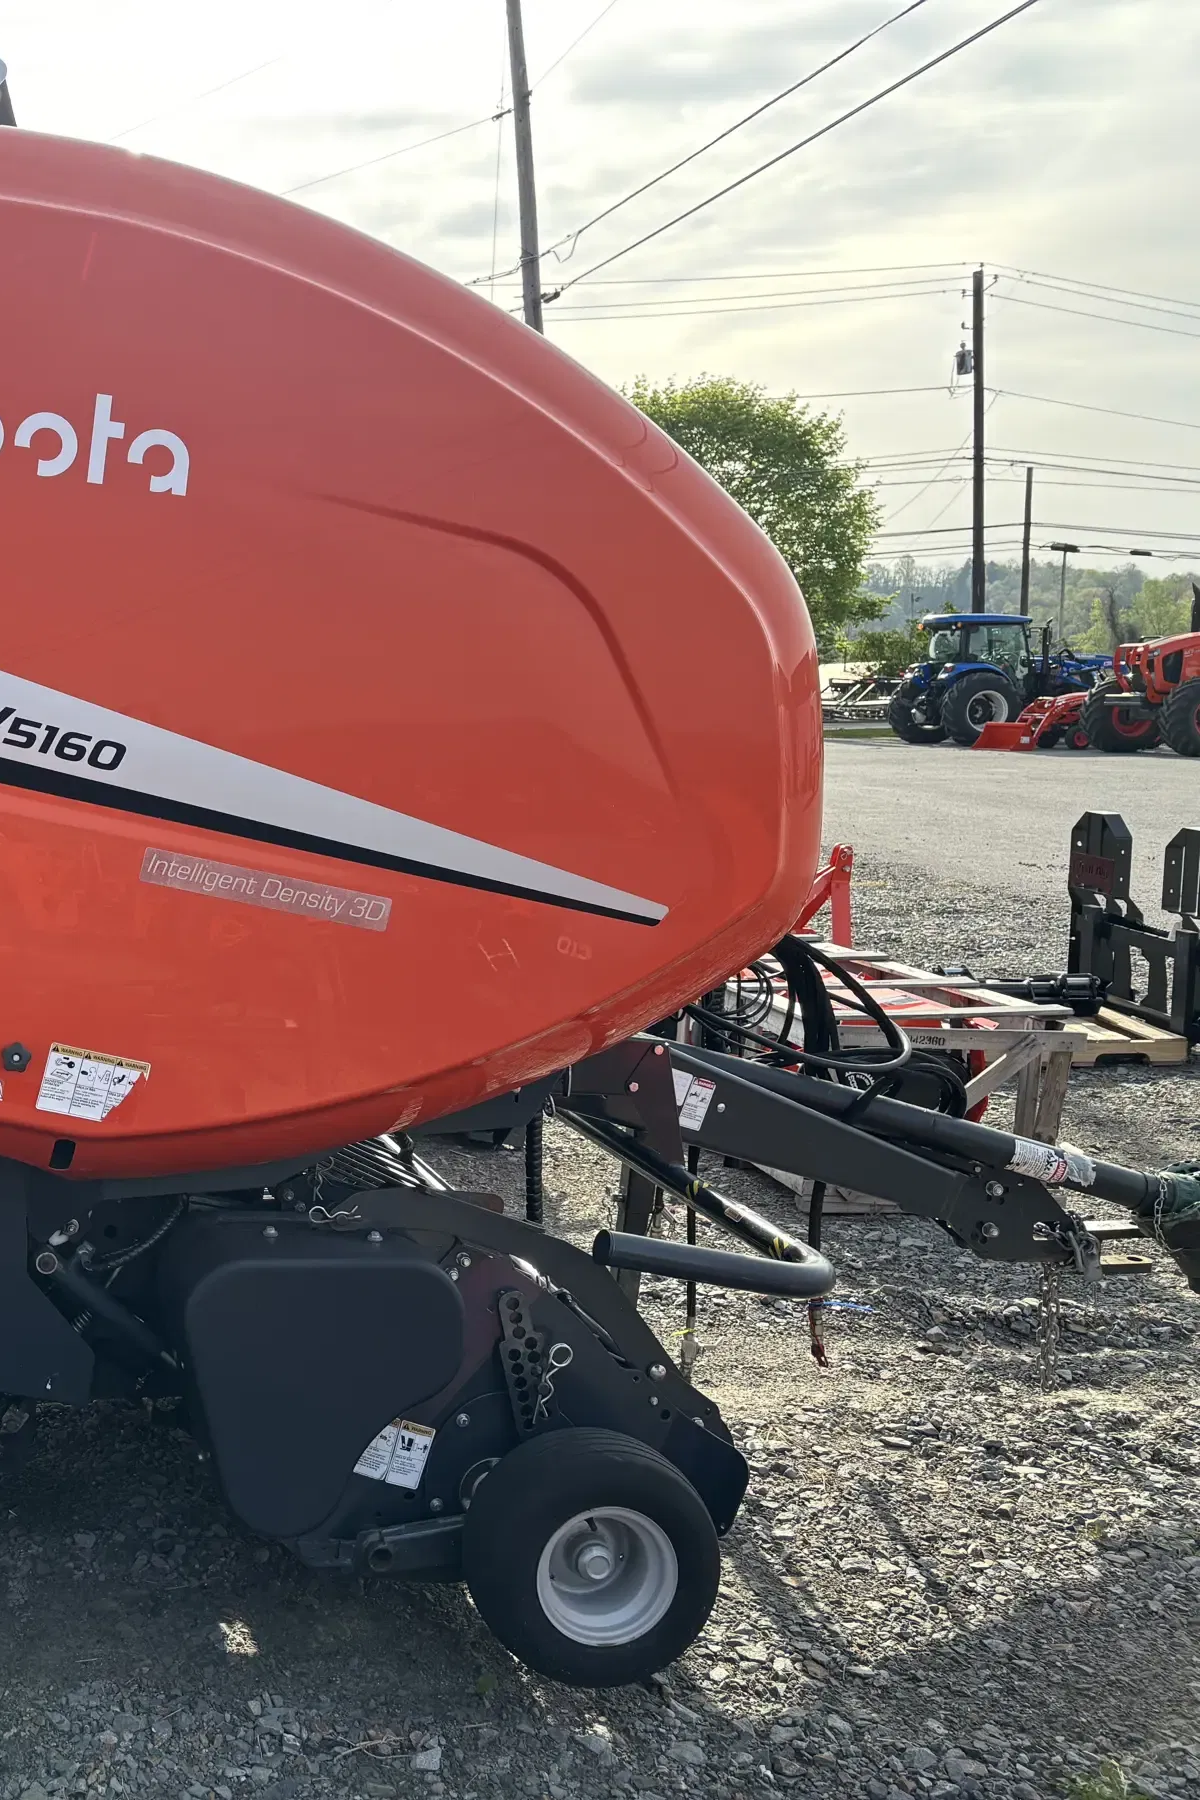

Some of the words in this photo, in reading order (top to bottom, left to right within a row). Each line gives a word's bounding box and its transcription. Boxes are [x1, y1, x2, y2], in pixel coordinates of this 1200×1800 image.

[147, 853, 257, 894] Intelligent
[260, 878, 346, 918] Density
[349, 897, 386, 922] 3D
[60, 1047, 83, 1057] WARNING
